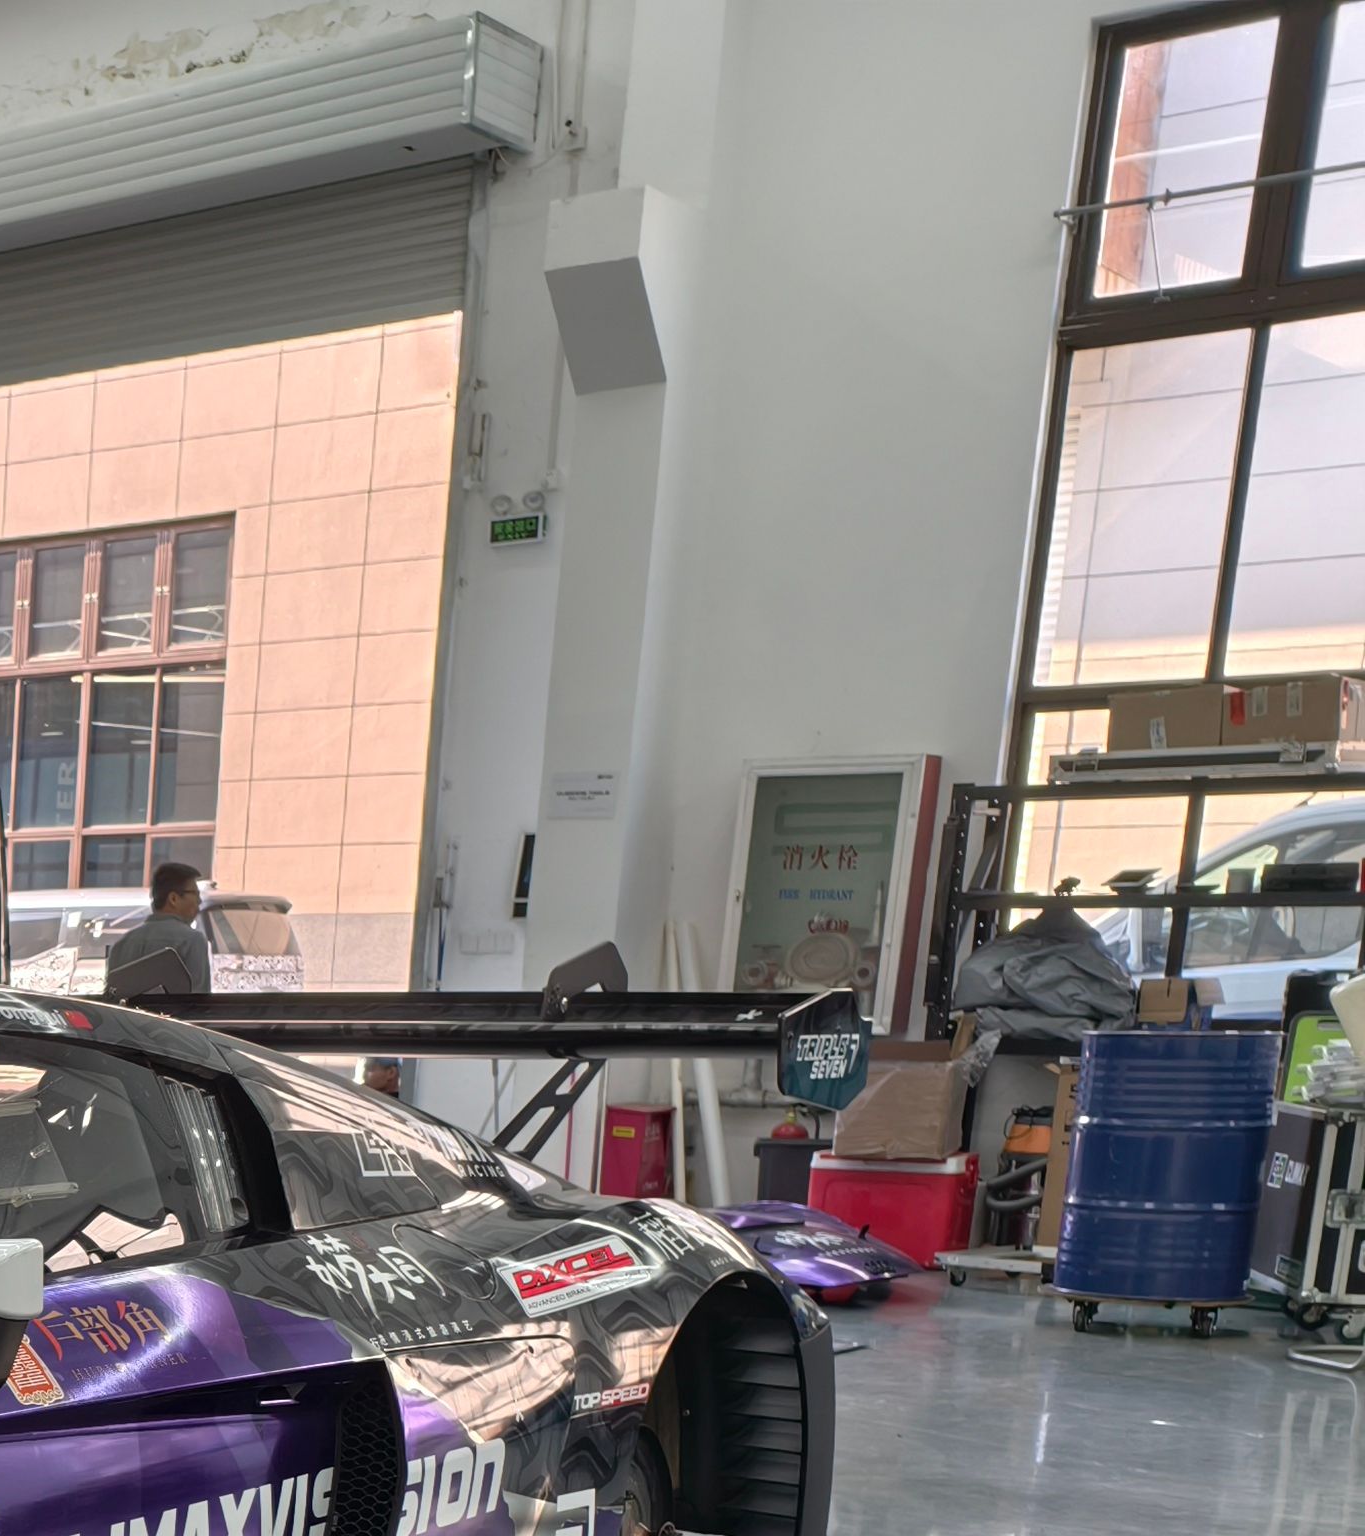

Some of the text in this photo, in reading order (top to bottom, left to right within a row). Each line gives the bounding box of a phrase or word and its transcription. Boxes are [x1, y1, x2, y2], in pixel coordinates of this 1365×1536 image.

[782, 844, 858, 870] 消火栓
[796, 1033, 851, 1062] TRIPLE
[810, 1059, 847, 1079] SEVEN
[458, 1163, 506, 1178] RACING
[574, 1382, 650, 1411] TOP SPEED
